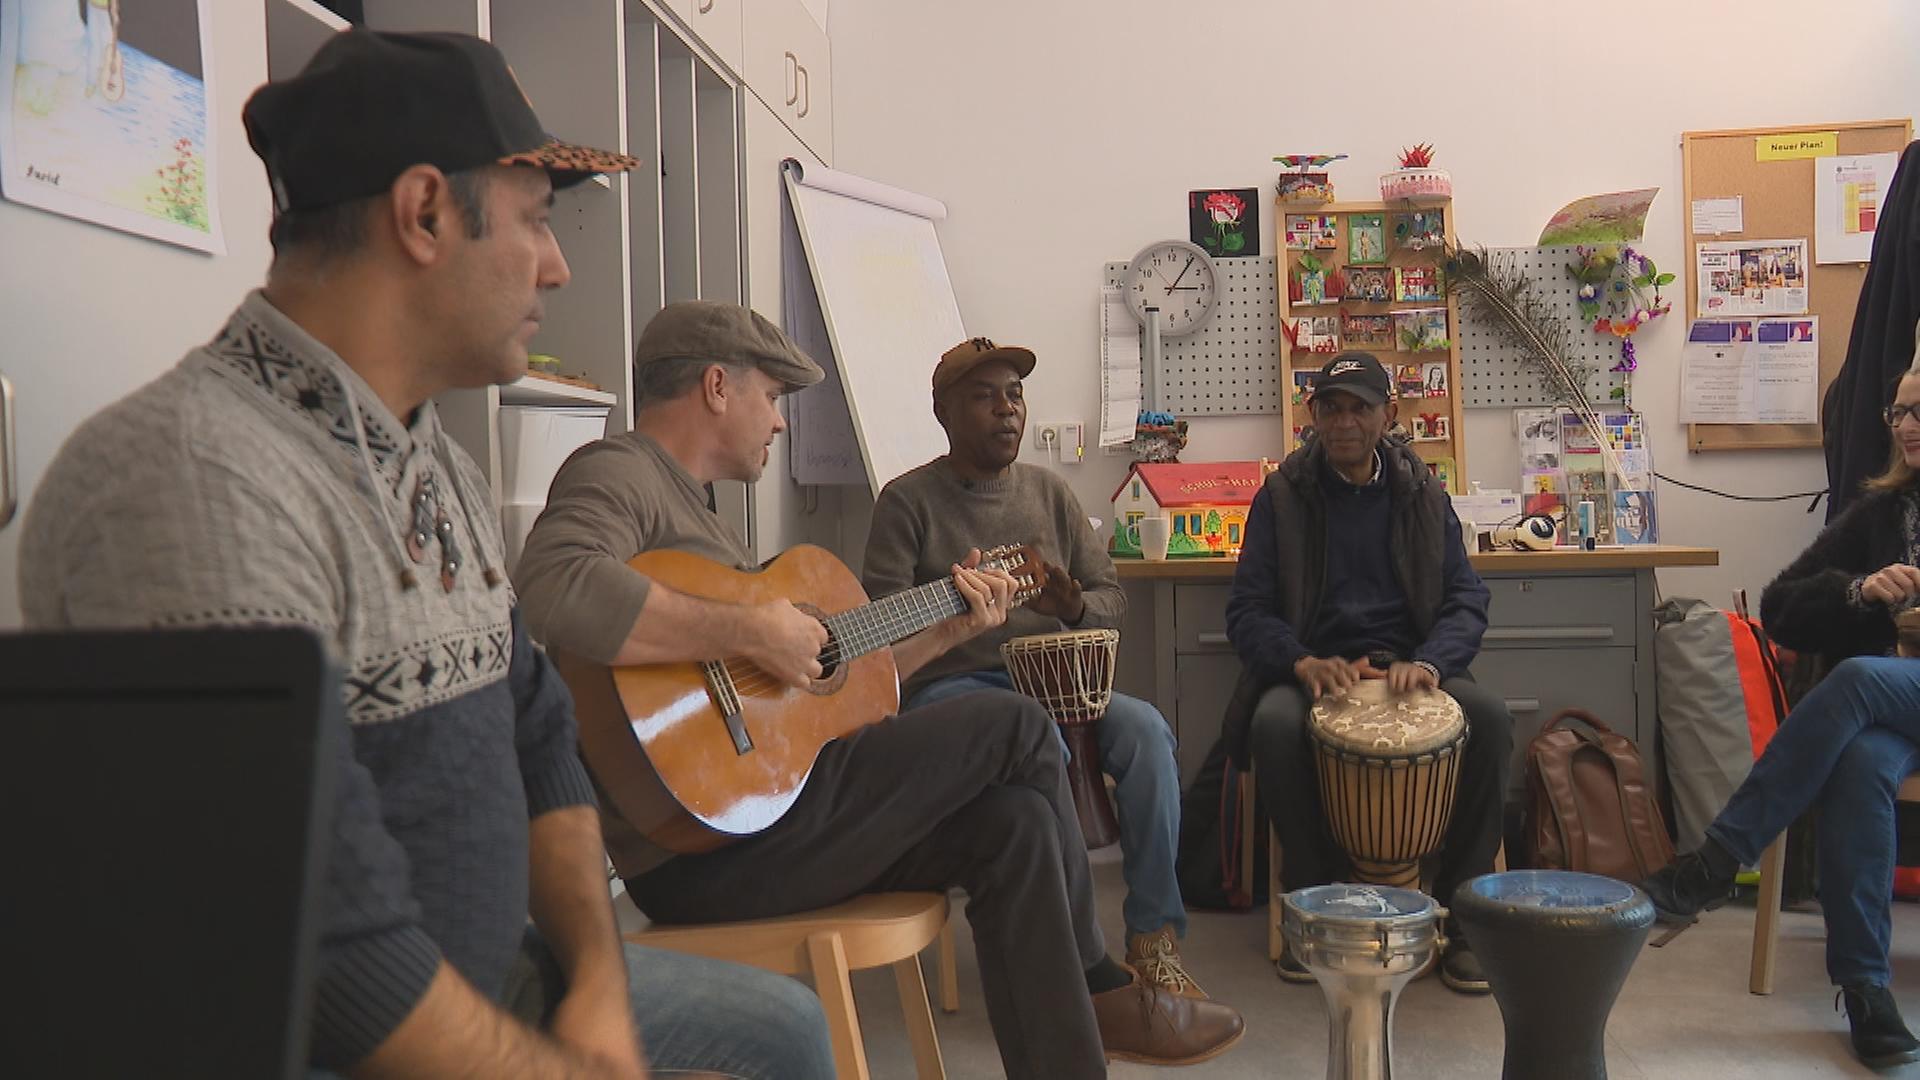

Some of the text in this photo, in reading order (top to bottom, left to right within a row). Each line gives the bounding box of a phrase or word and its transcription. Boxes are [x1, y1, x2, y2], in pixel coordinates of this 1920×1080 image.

[1770, 140, 1823, 152] Neuer Plan!
[1153, 258, 1161, 266] 11
[1167, 251, 1177, 263] 12
[1143, 269, 1153, 279] 10
[1195, 269, 1201, 277] 2
